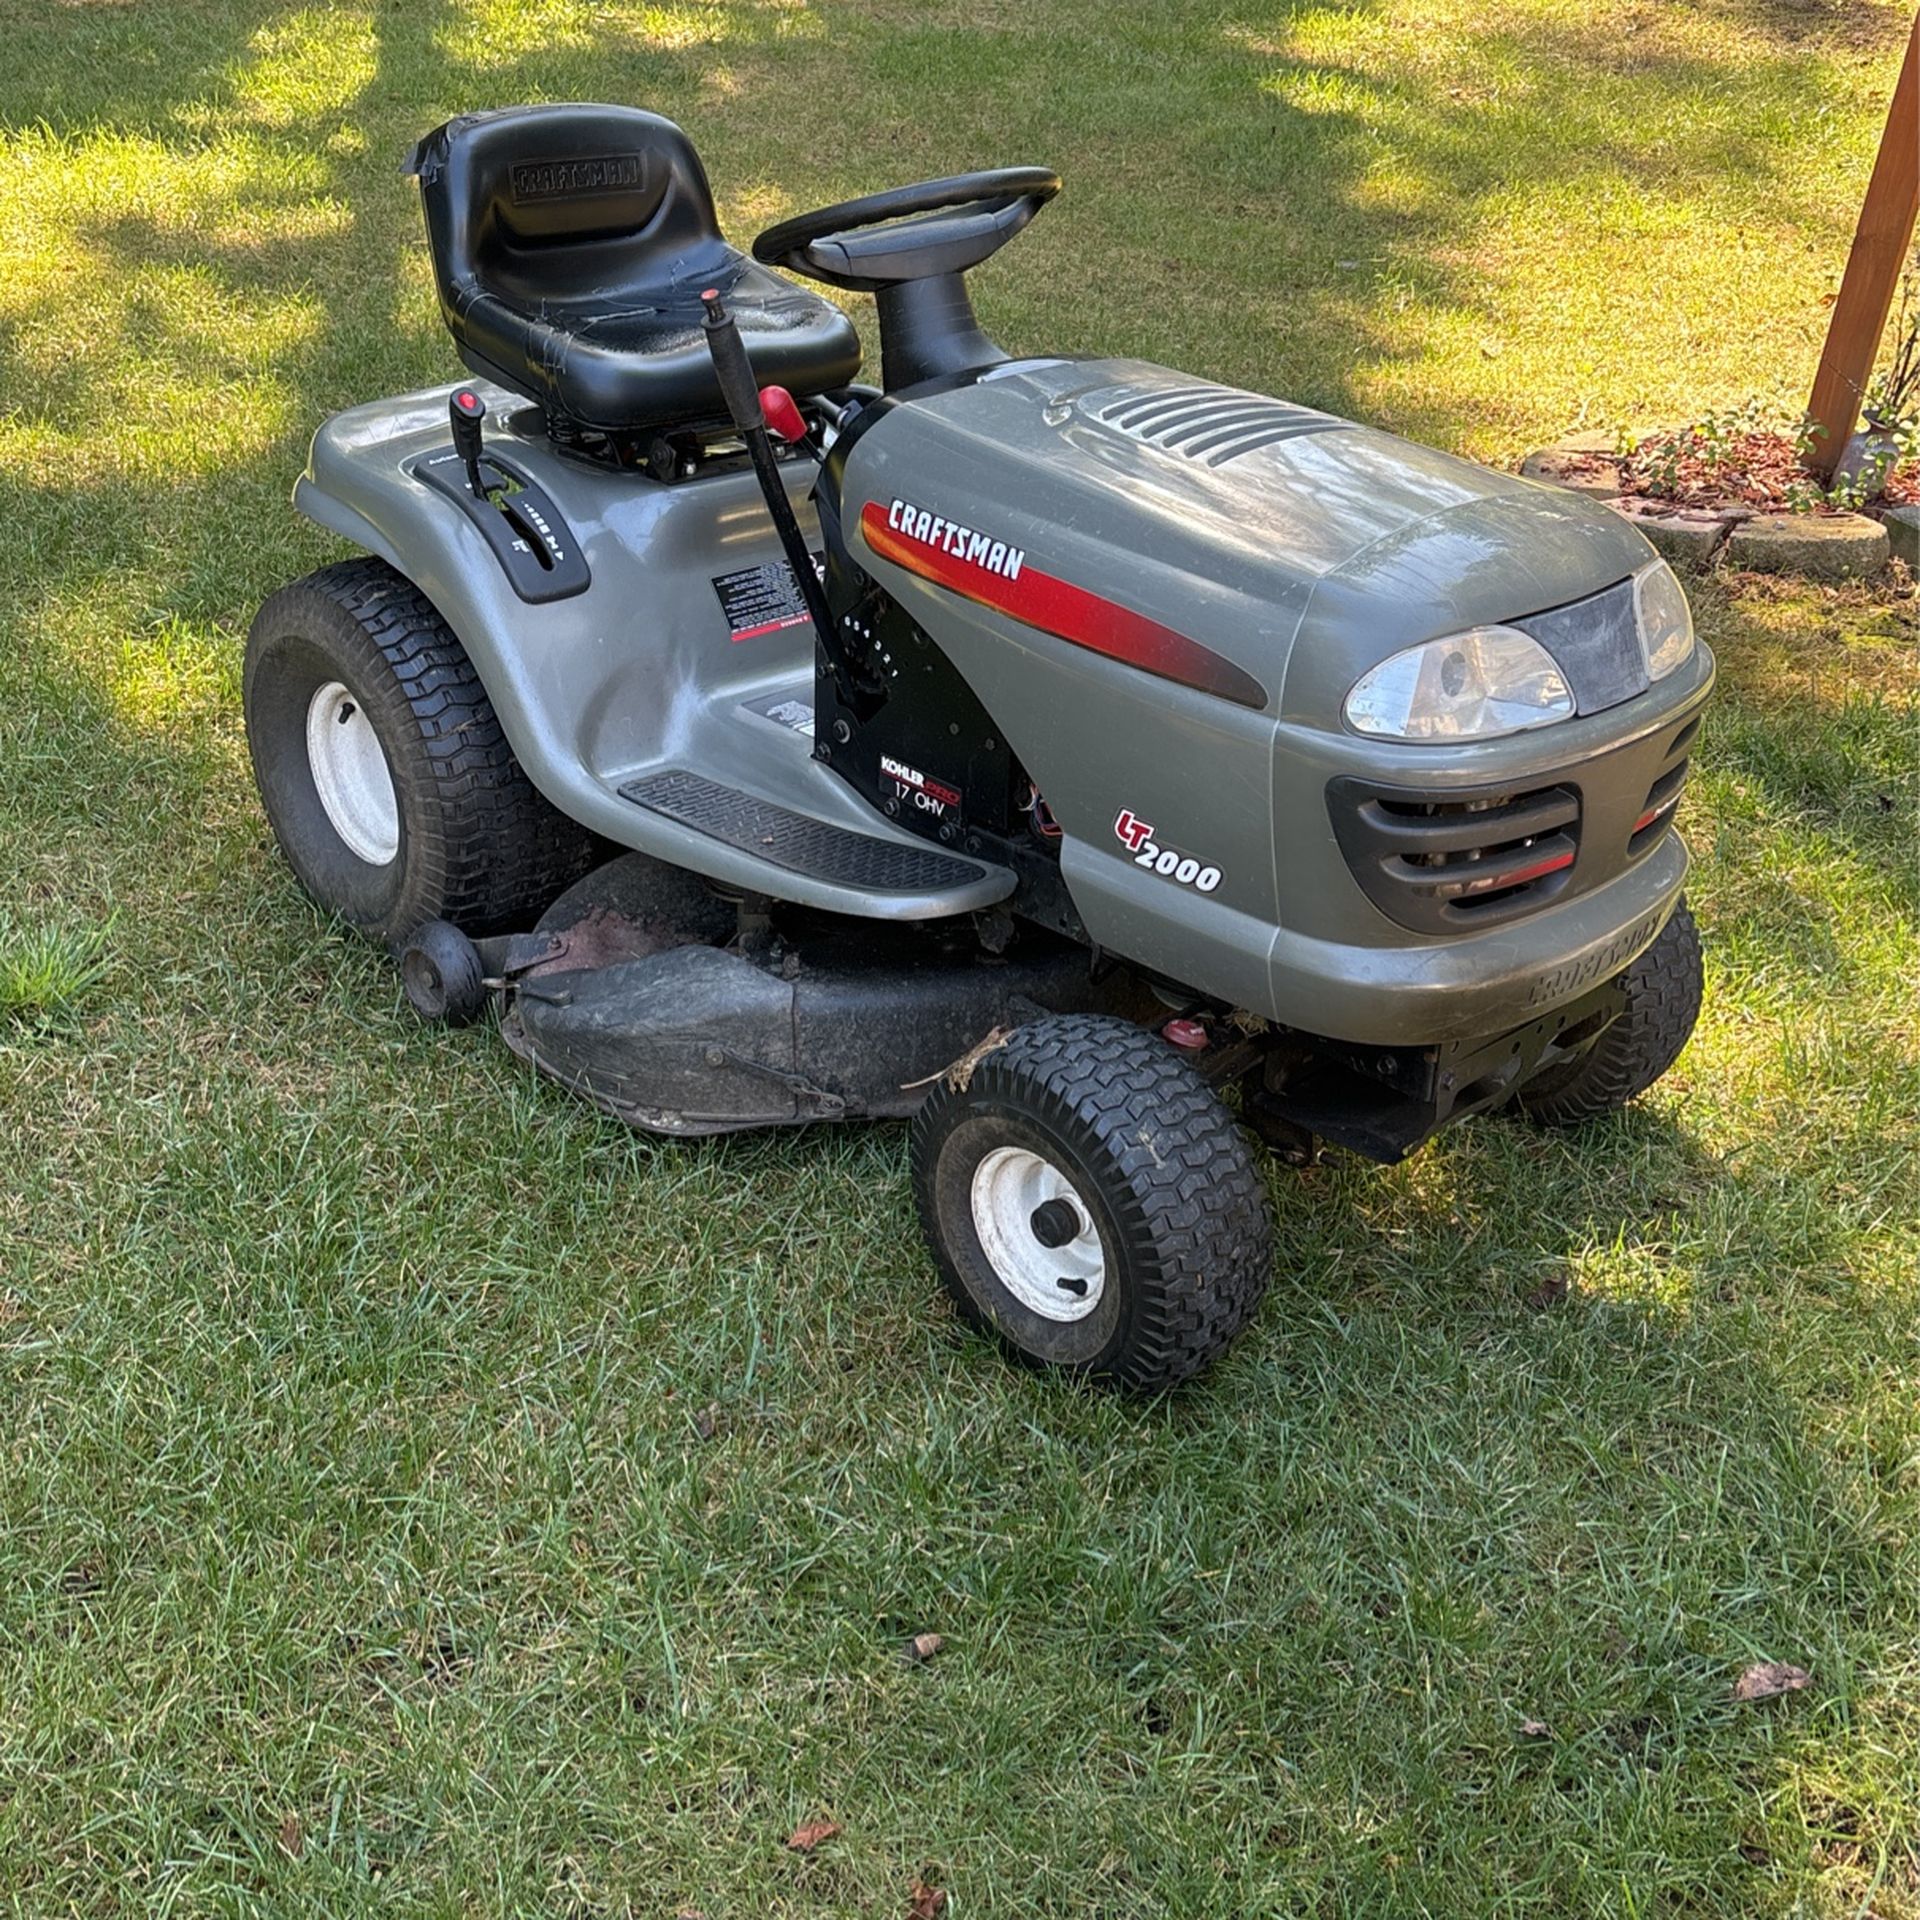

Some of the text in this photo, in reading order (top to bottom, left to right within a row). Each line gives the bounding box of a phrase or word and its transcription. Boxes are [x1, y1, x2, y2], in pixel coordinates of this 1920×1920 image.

[517, 159, 638, 194] CRAFTSMAN
[888, 499, 1025, 580] CRAFTSMAN
[881, 756, 960, 803] KOHLER PRO
[895, 781, 945, 816] 17 OHV
[1134, 841, 1221, 891] 2000
